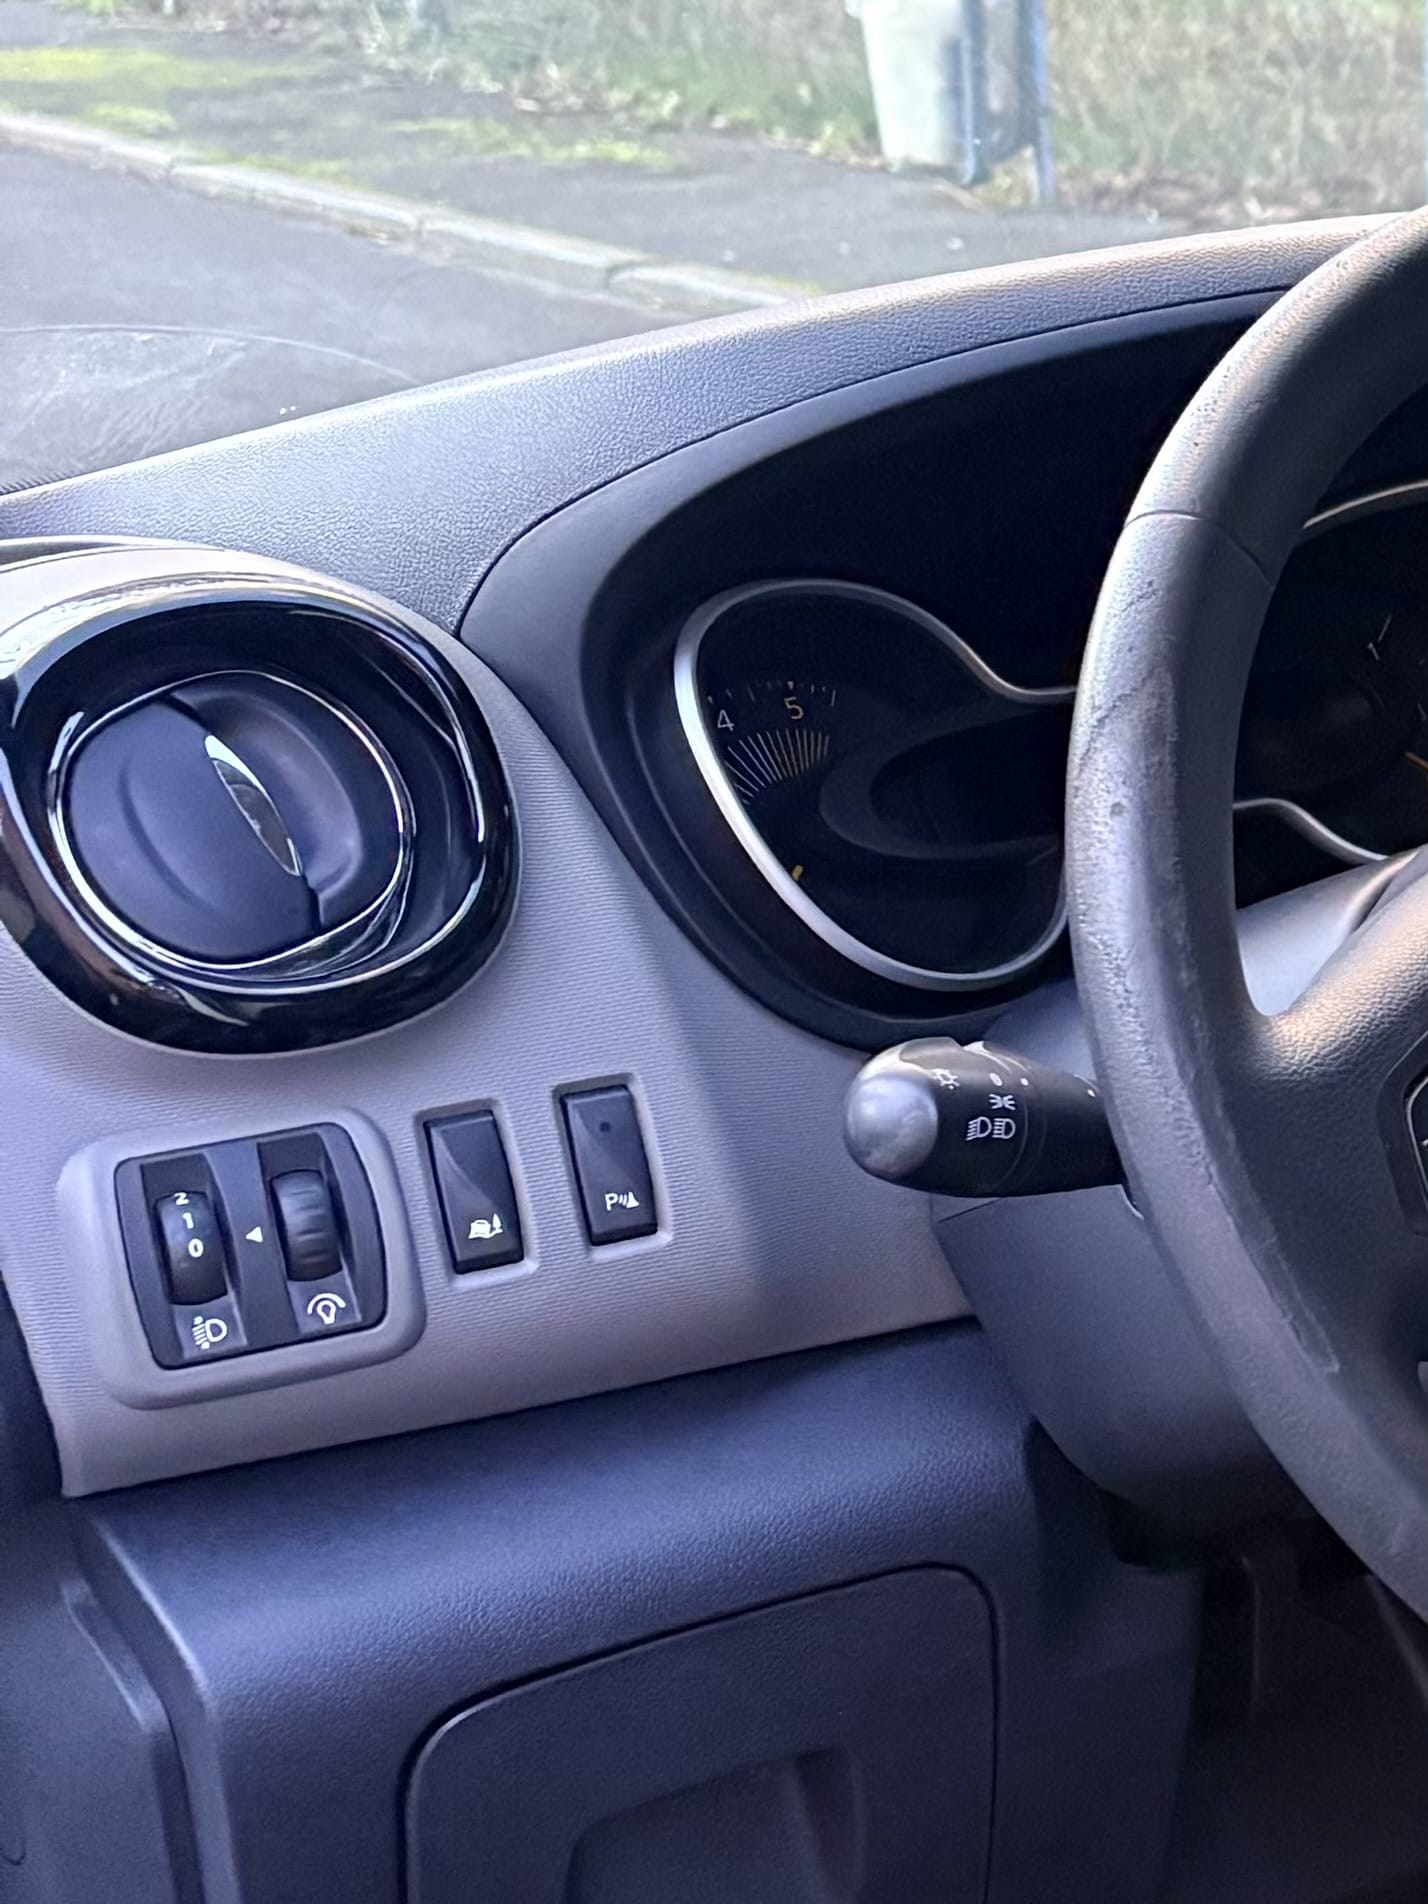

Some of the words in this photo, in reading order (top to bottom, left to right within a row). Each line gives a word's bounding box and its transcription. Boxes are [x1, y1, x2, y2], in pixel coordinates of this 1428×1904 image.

[784, 697, 804, 719] 5
[717, 709, 735, 732] 4
[174, 1192, 190, 1206] 2
[182, 1212, 194, 1229] 1
[188, 1238, 204, 1257] 0
